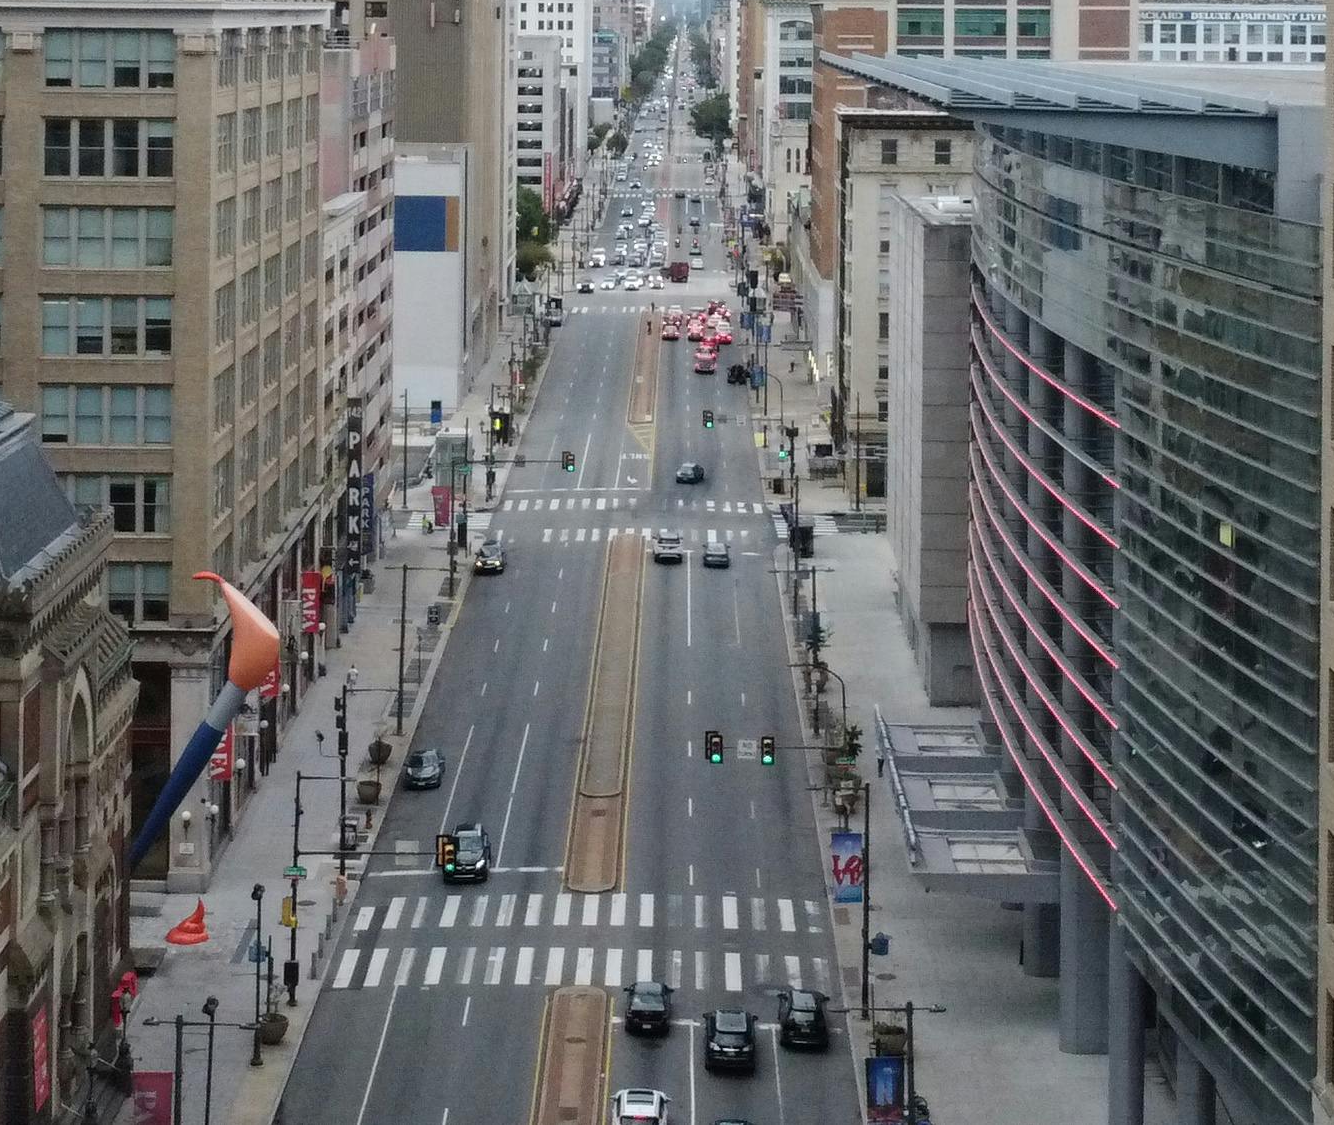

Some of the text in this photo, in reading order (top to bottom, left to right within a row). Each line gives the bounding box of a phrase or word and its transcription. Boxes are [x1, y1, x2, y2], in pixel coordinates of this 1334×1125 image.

[1190, 12, 1232, 20] DELUXE
[1232, 12, 1298, 20] APARTMENT
[349, 431, 361, 535] PARK
[361, 488, 370, 528] PARK
[302, 588, 317, 630] PAFA
